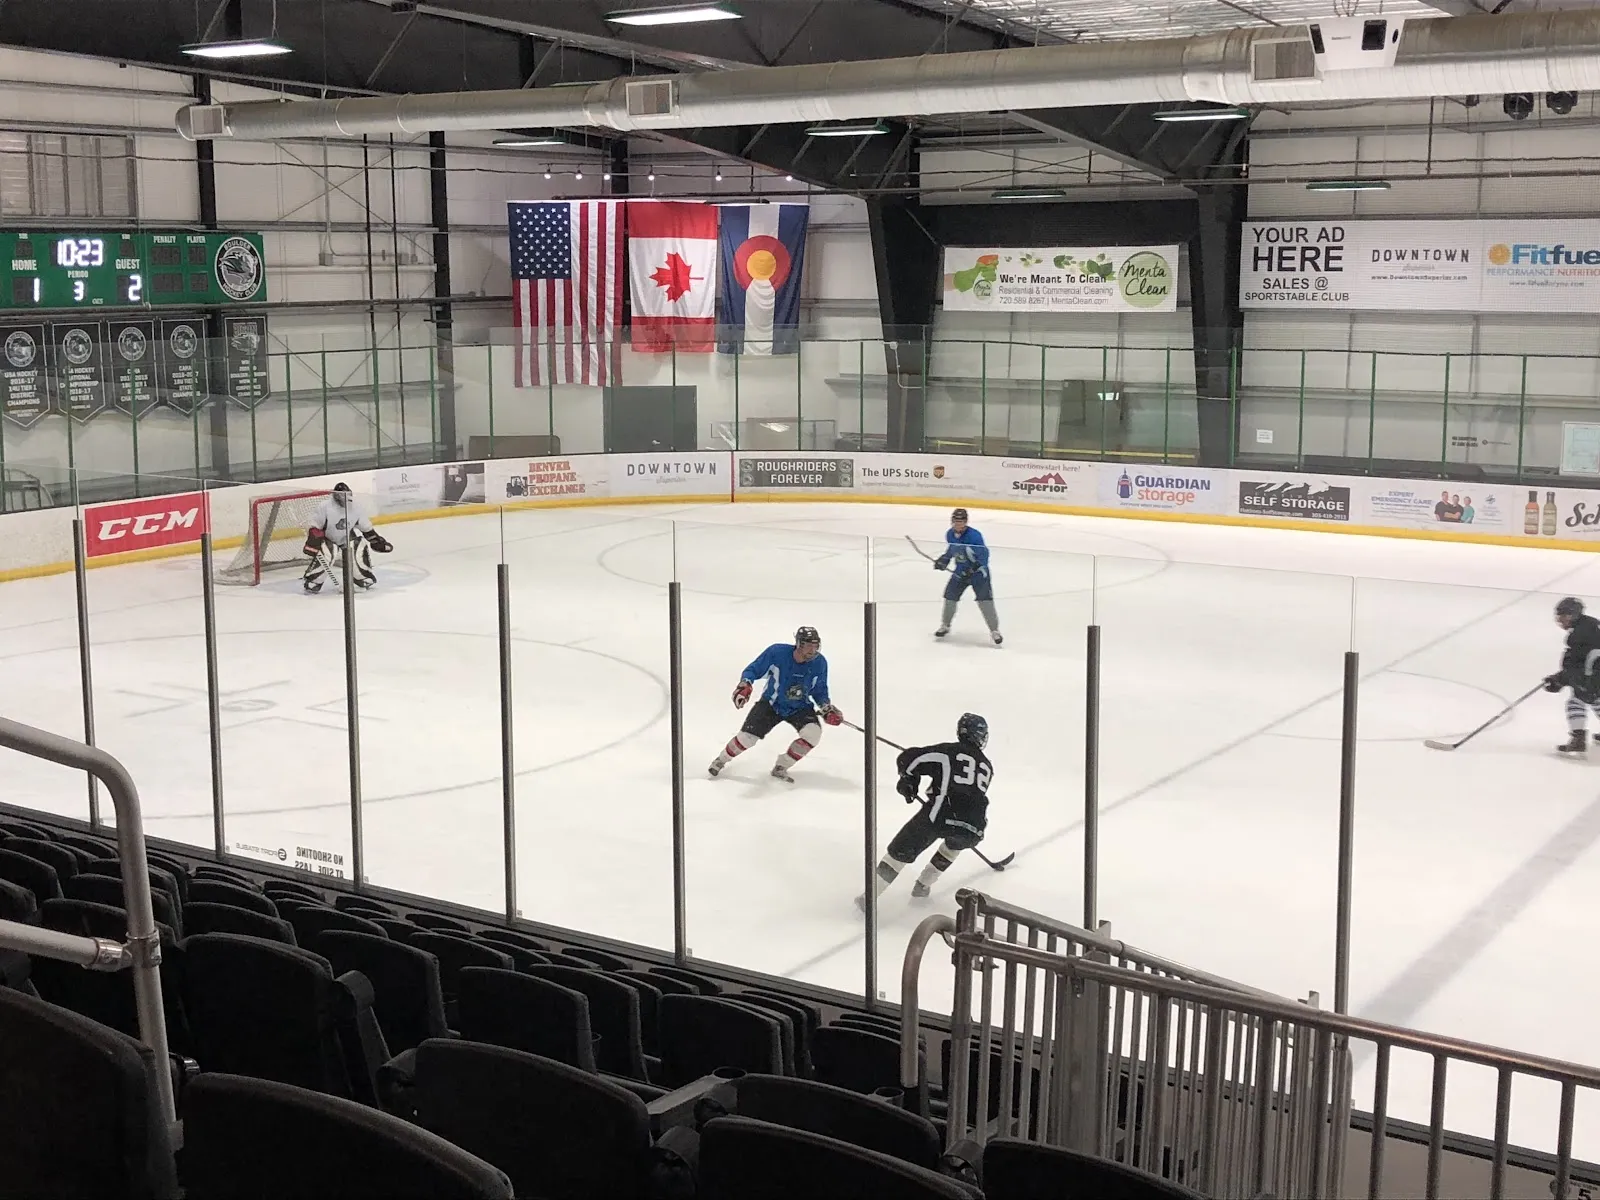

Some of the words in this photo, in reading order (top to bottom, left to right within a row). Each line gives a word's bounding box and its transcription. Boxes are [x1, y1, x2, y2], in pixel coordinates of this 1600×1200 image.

[153, 236, 176, 244] PENALTY
[186, 236, 206, 244] PLAYER
[1252, 227, 1308, 243] YOUR
[1316, 226, 1345, 242] AD
[224, 240, 251, 250] BOULDER
[57, 238, 104, 266] 10:23
[1372, 249, 1469, 262] DOWNTOWN
[12, 260, 37, 271] HOME
[115, 258, 140, 270] GUEST
[1252, 246, 1344, 272] HERE
[1121, 260, 1167, 278] Menta
[1486, 268, 1554, 276] PERFORMANCE
[999, 274, 1027, 284] We're
[1030, 274, 1062, 284] Meant
[1065, 274, 1076, 284] To
[1079, 274, 1106, 284] Clean
[1263, 278, 1309, 289] SALES
[1314, 276, 1328, 290] @
[33, 277, 40, 302] 1
[73, 280, 84, 302] 3
[128, 274, 142, 301] 2
[222, 283, 244, 298] HOCKEY
[244, 283, 258, 297] CLUB
[998, 286, 1034, 295] Residential
[1042, 286, 1081, 295] Commercial
[1083, 286, 1114, 296] Cleaning
[1125, 278, 1168, 295] Clean
[1244, 292, 1349, 301] SPORTSTABLE.CLUB
[528, 461, 570, 472] DENVER
[627, 462, 716, 476] DOWNTOWN
[757, 462, 836, 471] ROUGHRIDERS
[862, 468, 879, 476] The
[882, 468, 901, 477] UPS
[904, 469, 929, 478] Store
[529, 472, 576, 484] PROPANE
[771, 474, 823, 484] FOREVER
[1135, 475, 1211, 491] GUARDIAN
[529, 484, 586, 496] EXCHANGE
[1012, 481, 1068, 494] Superior
[1138, 488, 1195, 506] storage
[1244, 496, 1277, 507] SELF
[1281, 498, 1345, 511] STORAGE
[98, 507, 198, 540] CCM
[953, 753, 992, 793] 32
